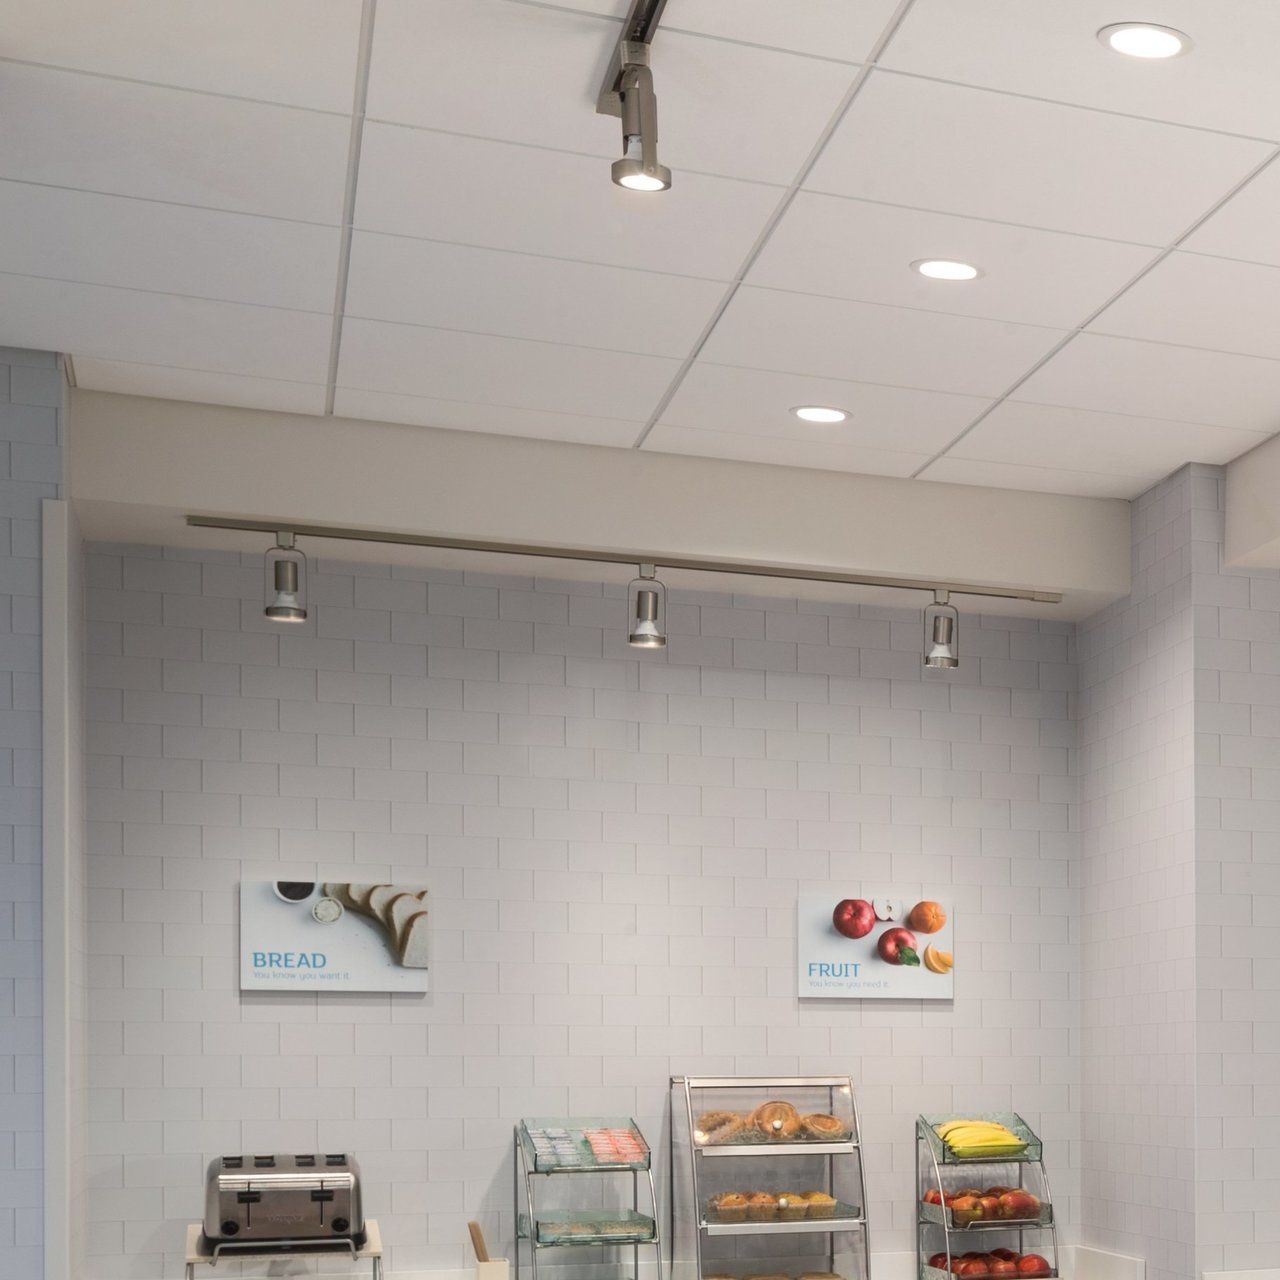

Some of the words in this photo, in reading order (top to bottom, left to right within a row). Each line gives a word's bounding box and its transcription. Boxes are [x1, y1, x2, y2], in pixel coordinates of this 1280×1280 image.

[252, 952, 327, 968] BREAD
[253, 971, 270, 979] You
[273, 970, 296, 980] know
[299, 972, 317, 981] you
[319, 971, 340, 980] want
[808, 962, 861, 977] FRUIT
